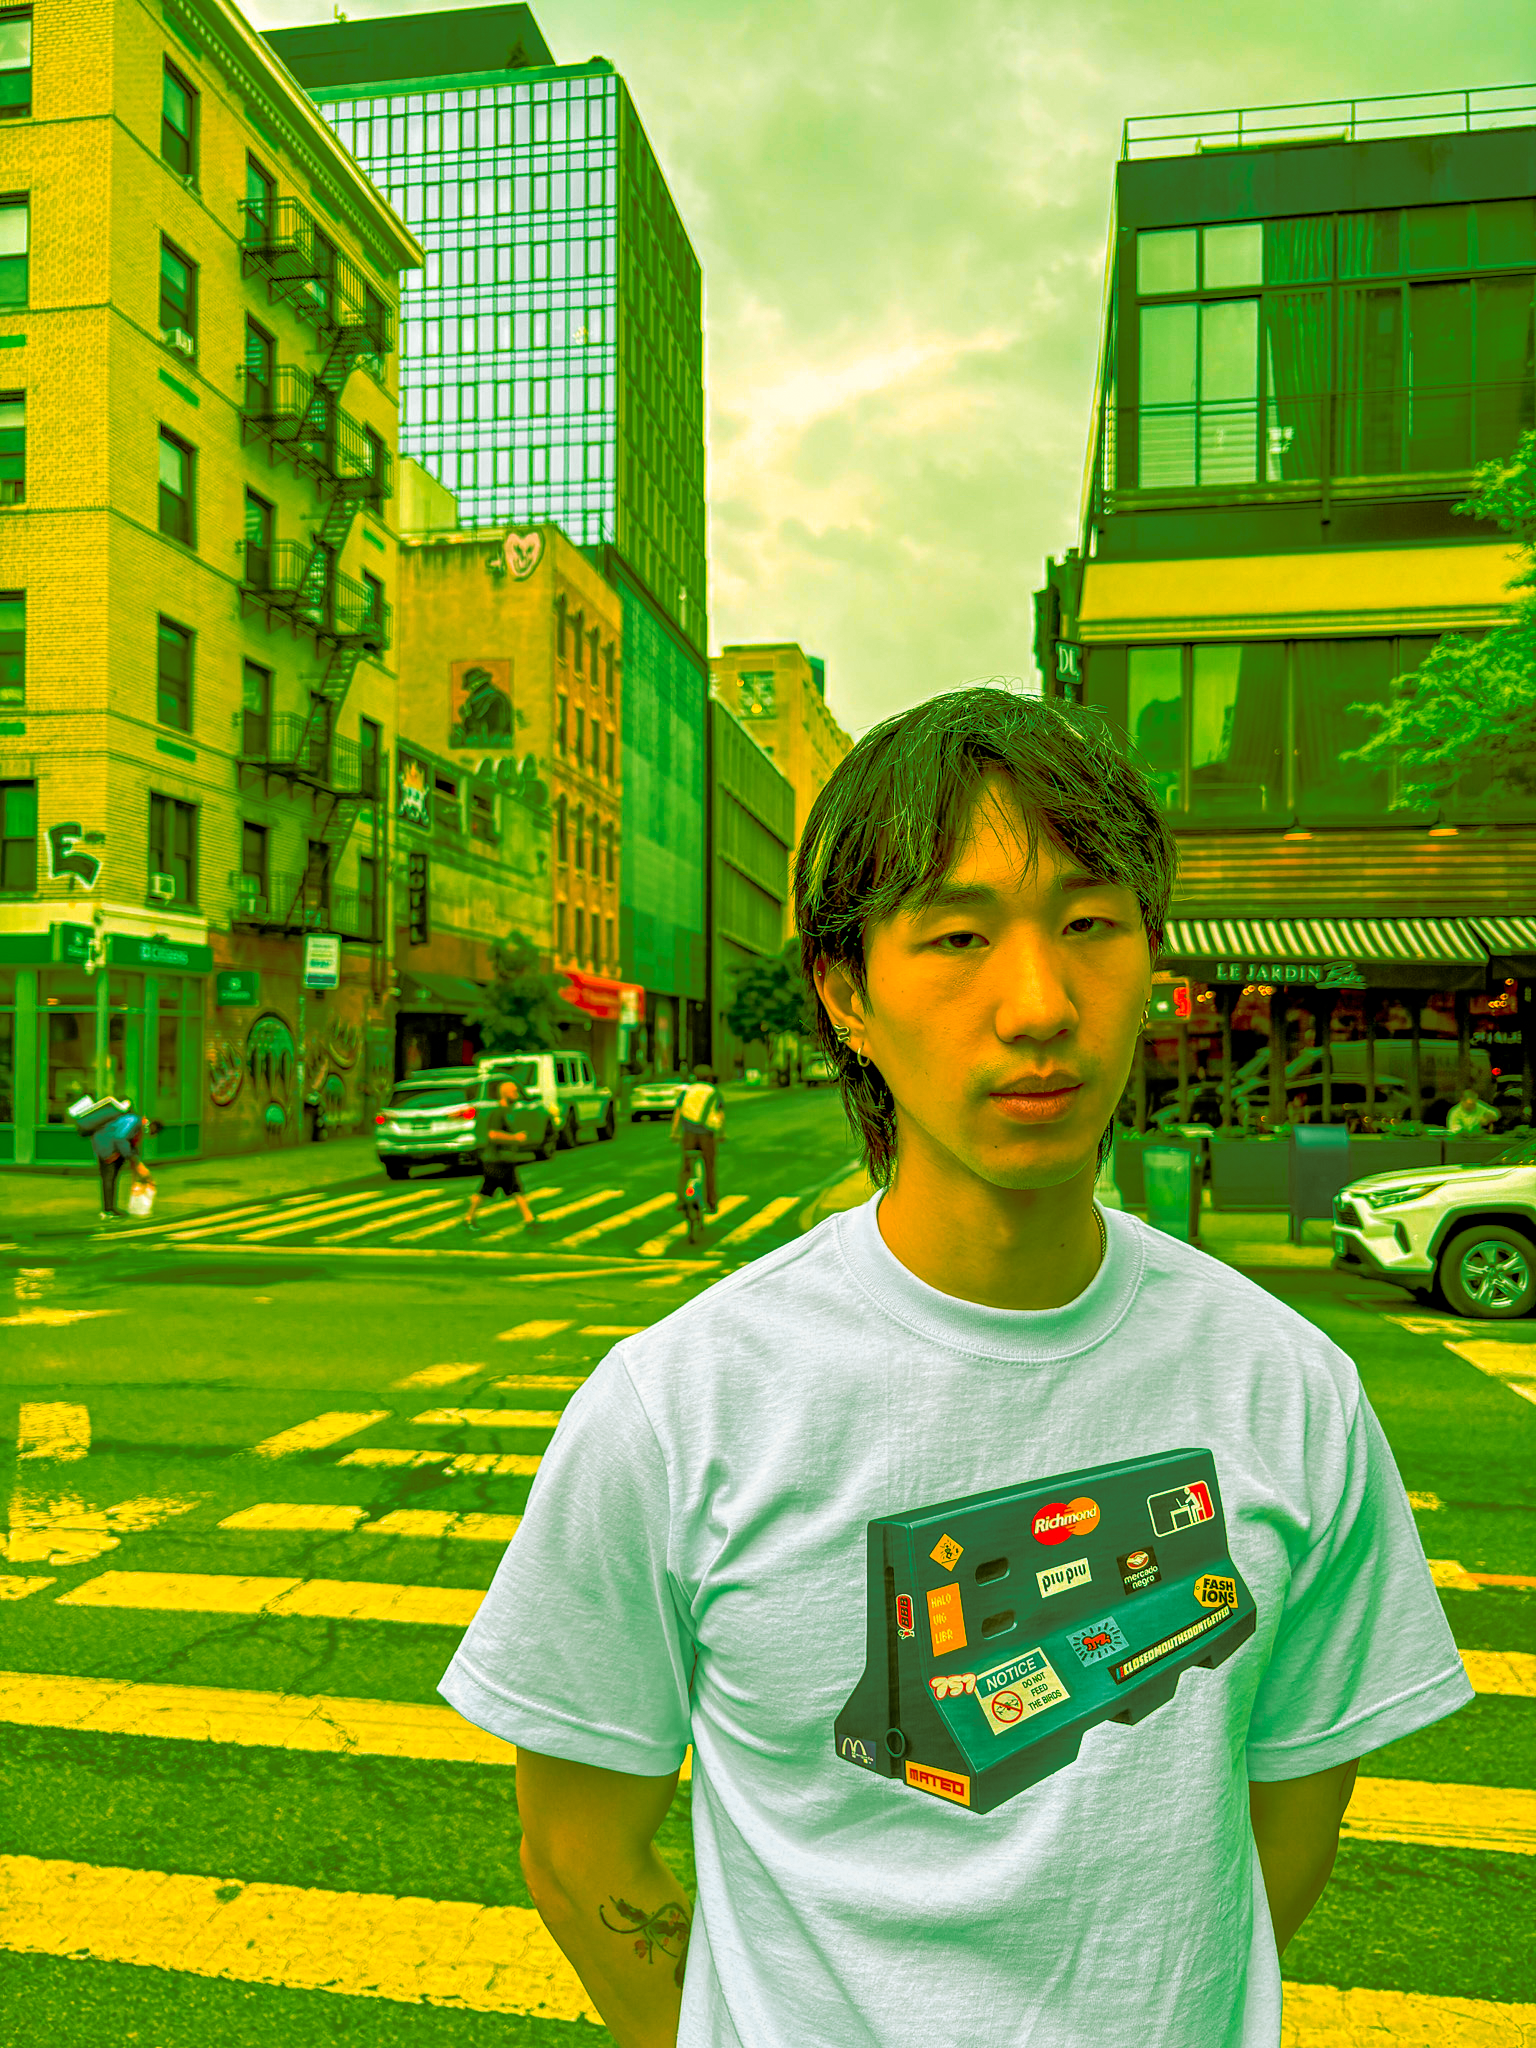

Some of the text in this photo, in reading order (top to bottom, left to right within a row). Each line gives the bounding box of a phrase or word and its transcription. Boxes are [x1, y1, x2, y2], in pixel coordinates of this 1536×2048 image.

[1216, 962, 1242, 981] LE
[1246, 963, 1323, 983] JARDIN
[1034, 1504, 1097, 1535] Richmond
[1123, 1565, 1159, 1585] mercado
[1132, 1574, 1155, 1590] negro
[1202, 1577, 1234, 1592] FASH
[931, 1592, 952, 1609] HALO
[1201, 1589, 1235, 1604] IONS
[900, 1597, 910, 1628] BBB
[1122, 1605, 1231, 1677] CLOSEDMOUTHSDONTGETFED
[985, 1657, 1037, 1692] NOTICE
[1021, 1671, 1046, 1689] DO NOT
[930, 1673, 977, 1700] 757
[1030, 1683, 1049, 1697] FEED
[1027, 1689, 1063, 1711] THE BIRDS
